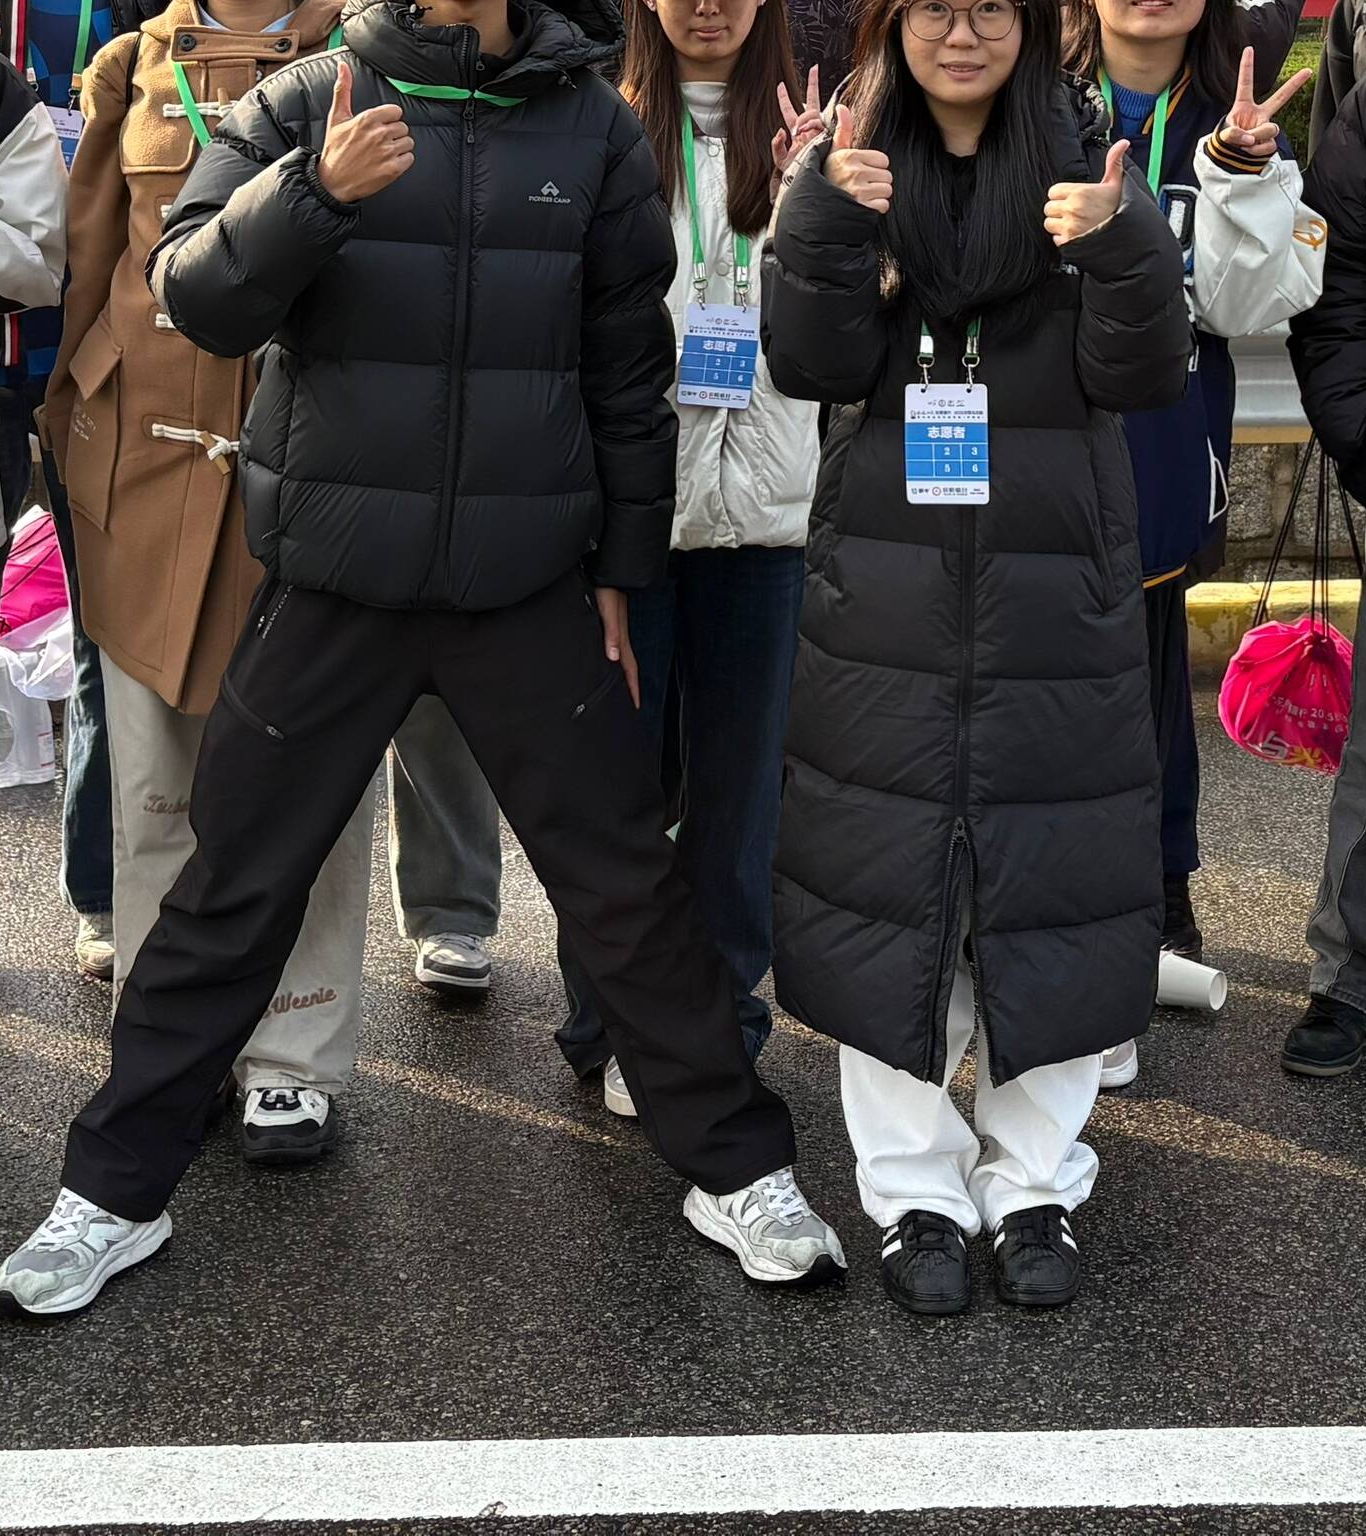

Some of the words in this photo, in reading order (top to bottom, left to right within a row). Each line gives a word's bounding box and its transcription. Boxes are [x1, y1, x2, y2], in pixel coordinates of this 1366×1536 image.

[927, 426, 966, 439] 志愿者
[270, 987, 337, 1014] Weenie
